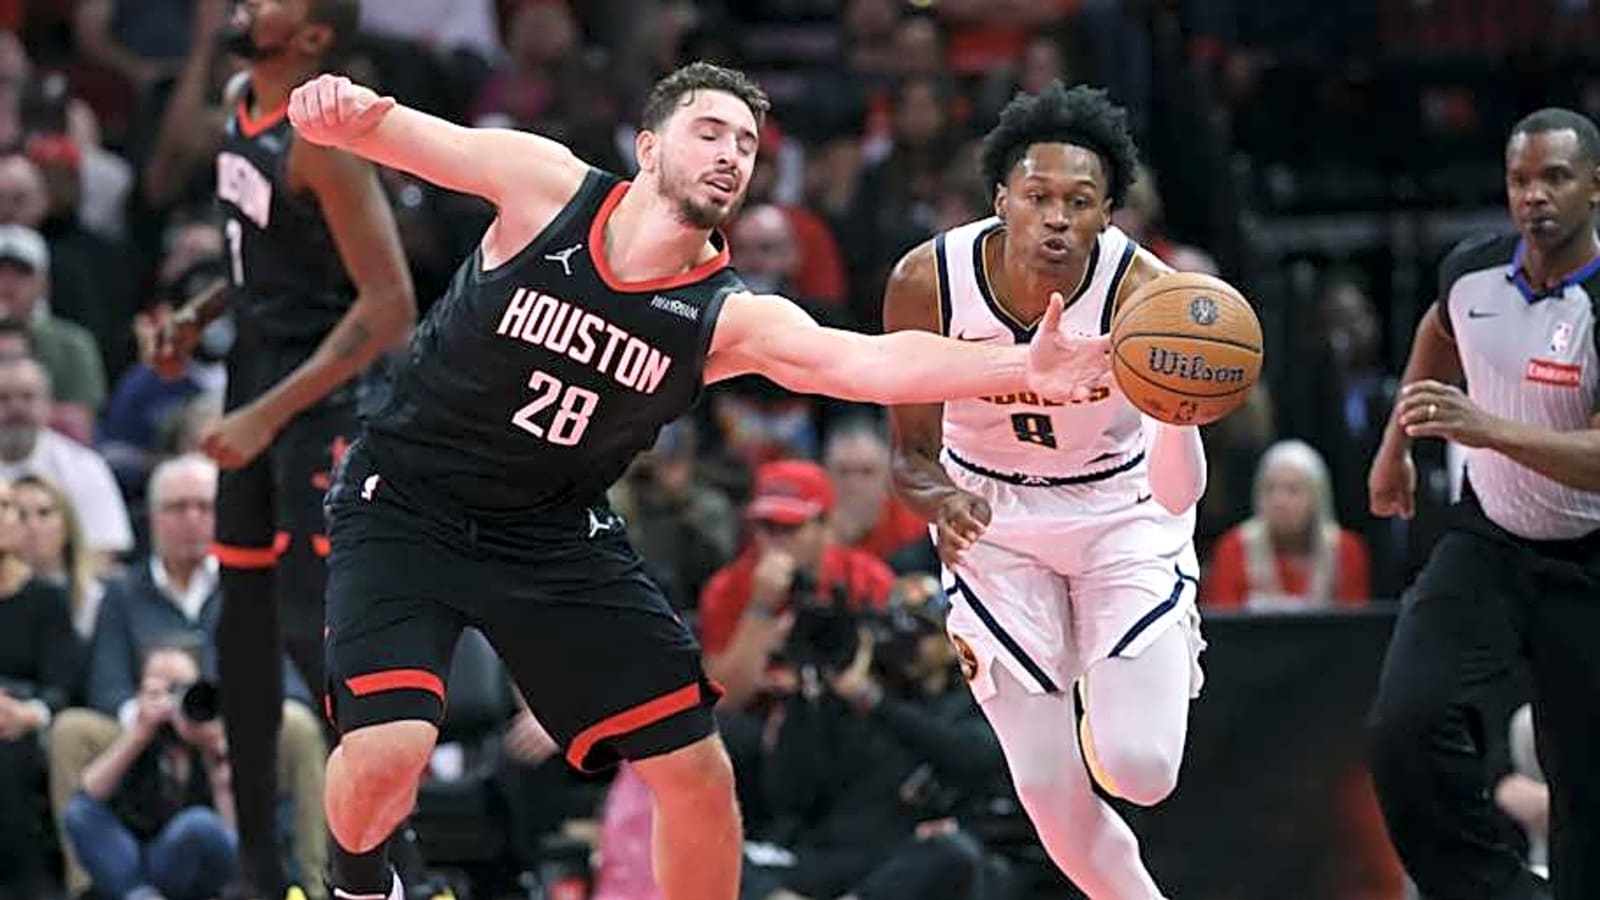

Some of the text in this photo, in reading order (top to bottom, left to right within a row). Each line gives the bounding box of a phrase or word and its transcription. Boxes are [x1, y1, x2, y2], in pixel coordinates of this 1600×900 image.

[497, 287, 672, 394] HOUSTON
[1149, 346, 1245, 383] Wilson
[511, 370, 600, 446] 28
